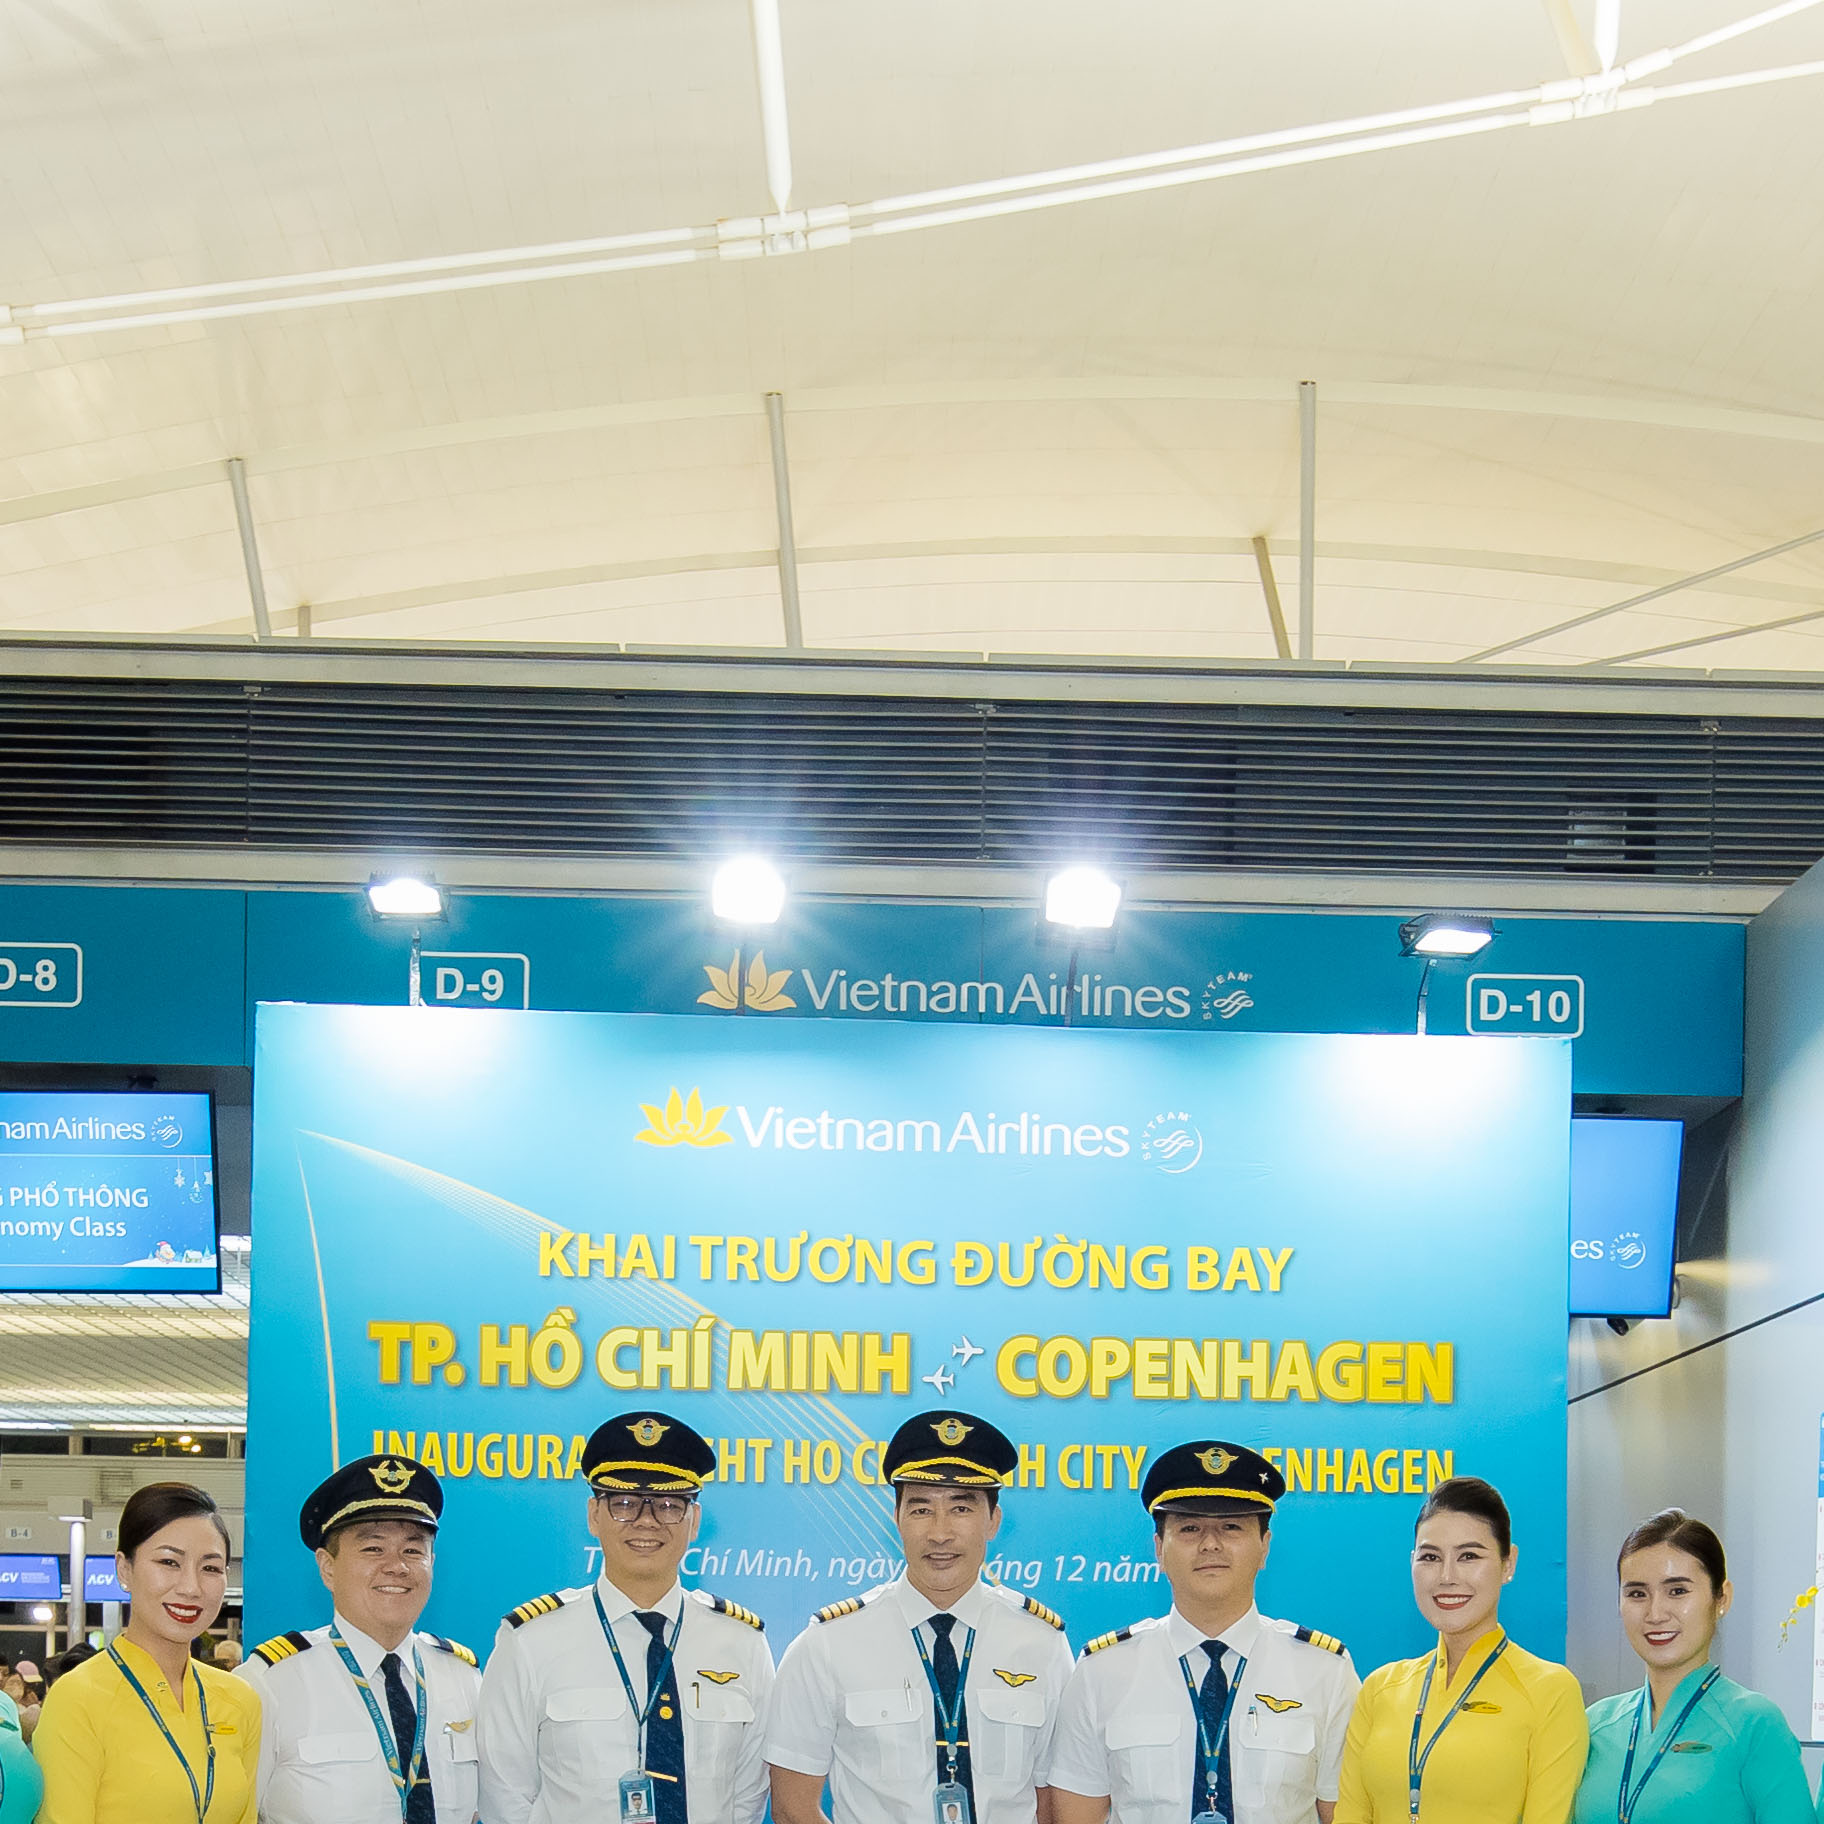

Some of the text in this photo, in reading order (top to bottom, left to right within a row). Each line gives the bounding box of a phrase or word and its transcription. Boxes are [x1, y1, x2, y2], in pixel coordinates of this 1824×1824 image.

[436, 967, 504, 1001] D-9
[801, 968, 1002, 1016] Vietnam
[1008, 974, 1191, 1019] Airlines
[1479, 988, 1571, 1023] D-10
[51, 1117, 146, 1141] Airlines
[737, 1106, 941, 1154] Vietnam
[946, 1111, 1130, 1158] Airlines
[10, 1180, 59, 1207] PHỔ
[63, 1184, 149, 1208] THÔNG
[70, 1215, 127, 1237] Class
[538, 1230, 1294, 1292] KHAI TRƯƠNG ĐƯỜNG BAY
[368, 1306, 1455, 1404] TP. HỒ CHÍ MINH COPENHAGEN
[373, 1430, 587, 1480] INAUGURA
[784, 1439, 842, 1485] HO
[1058, 1444, 1147, 1489] CITY
[1262, 1447, 1454, 1494] NHAGEN
[680, 1548, 1160, 1588] Chí Minh, ngày áng 12 năm
